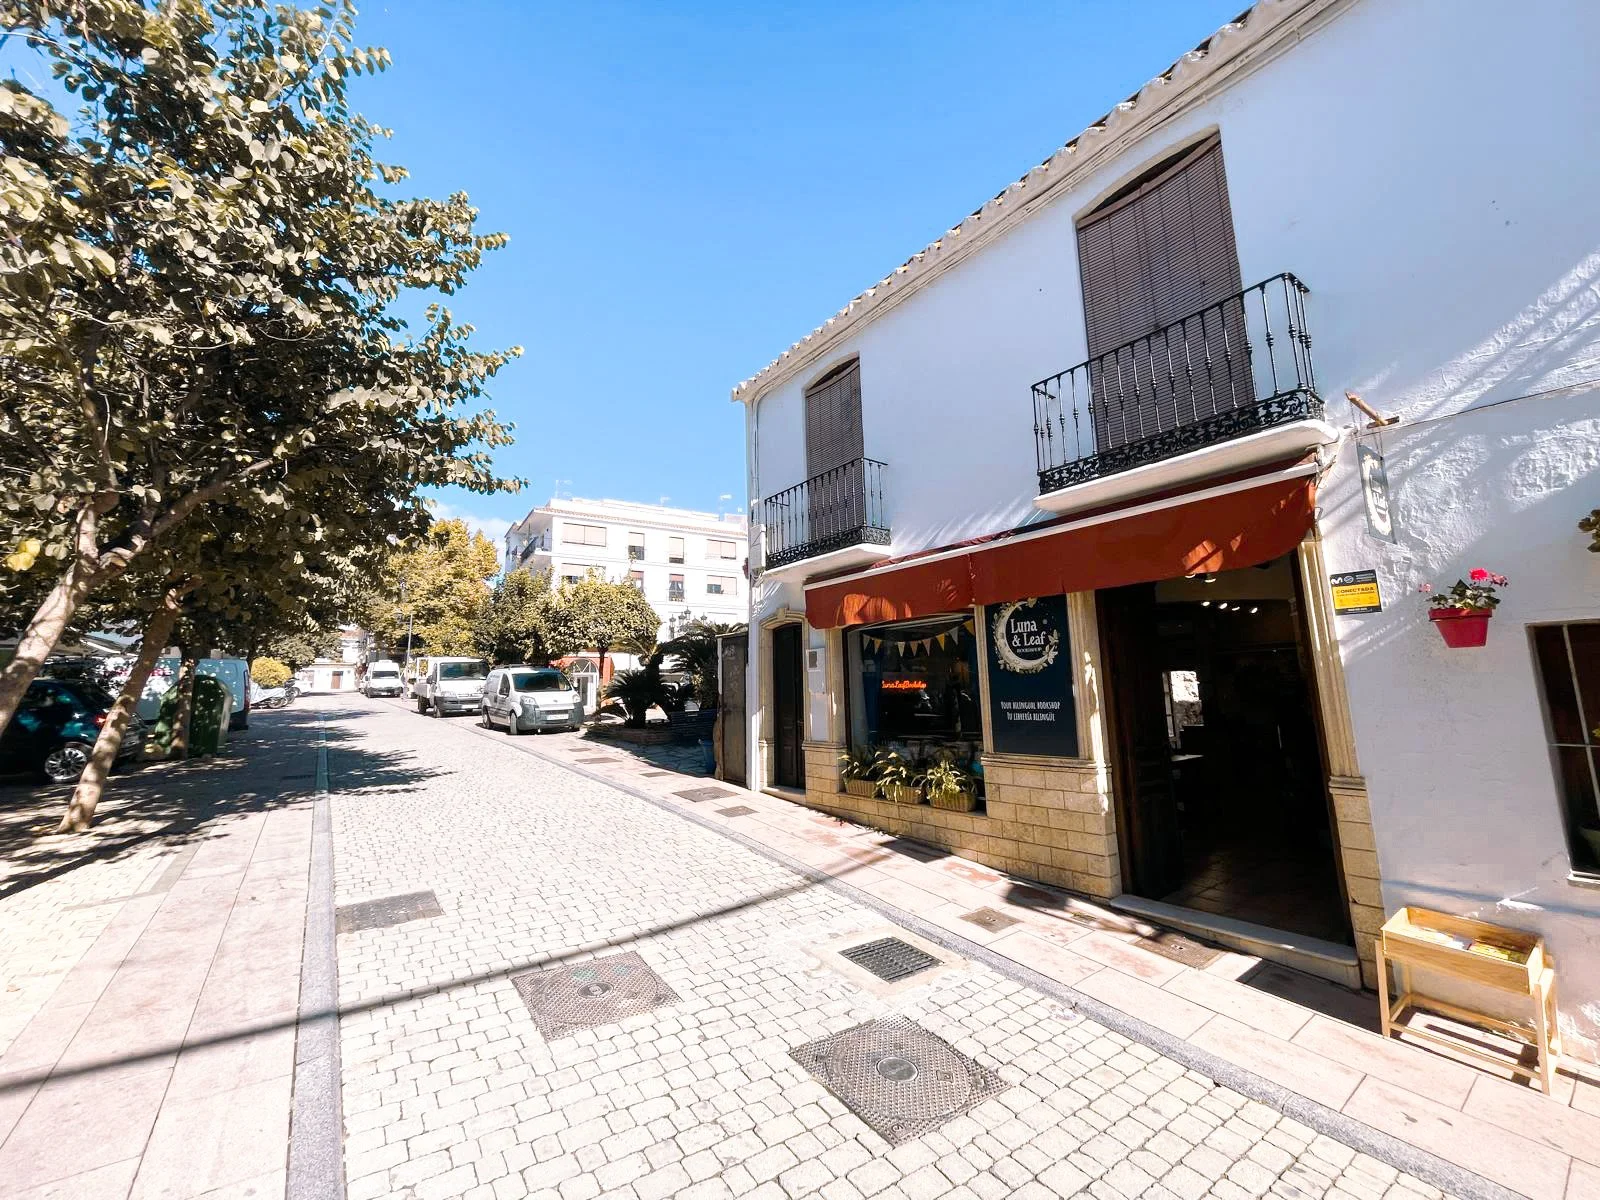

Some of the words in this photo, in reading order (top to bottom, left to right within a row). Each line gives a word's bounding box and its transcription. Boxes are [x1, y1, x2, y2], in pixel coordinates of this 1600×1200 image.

[1010, 618, 1038, 634] Luna
[1012, 634, 1021, 647] &
[1023, 631, 1047, 646] Leaf
[1001, 701, 1012, 710] YOUR
[1013, 701, 1036, 710] BILINGUAL
[1037, 701, 1060, 710] BOOKSHOP
